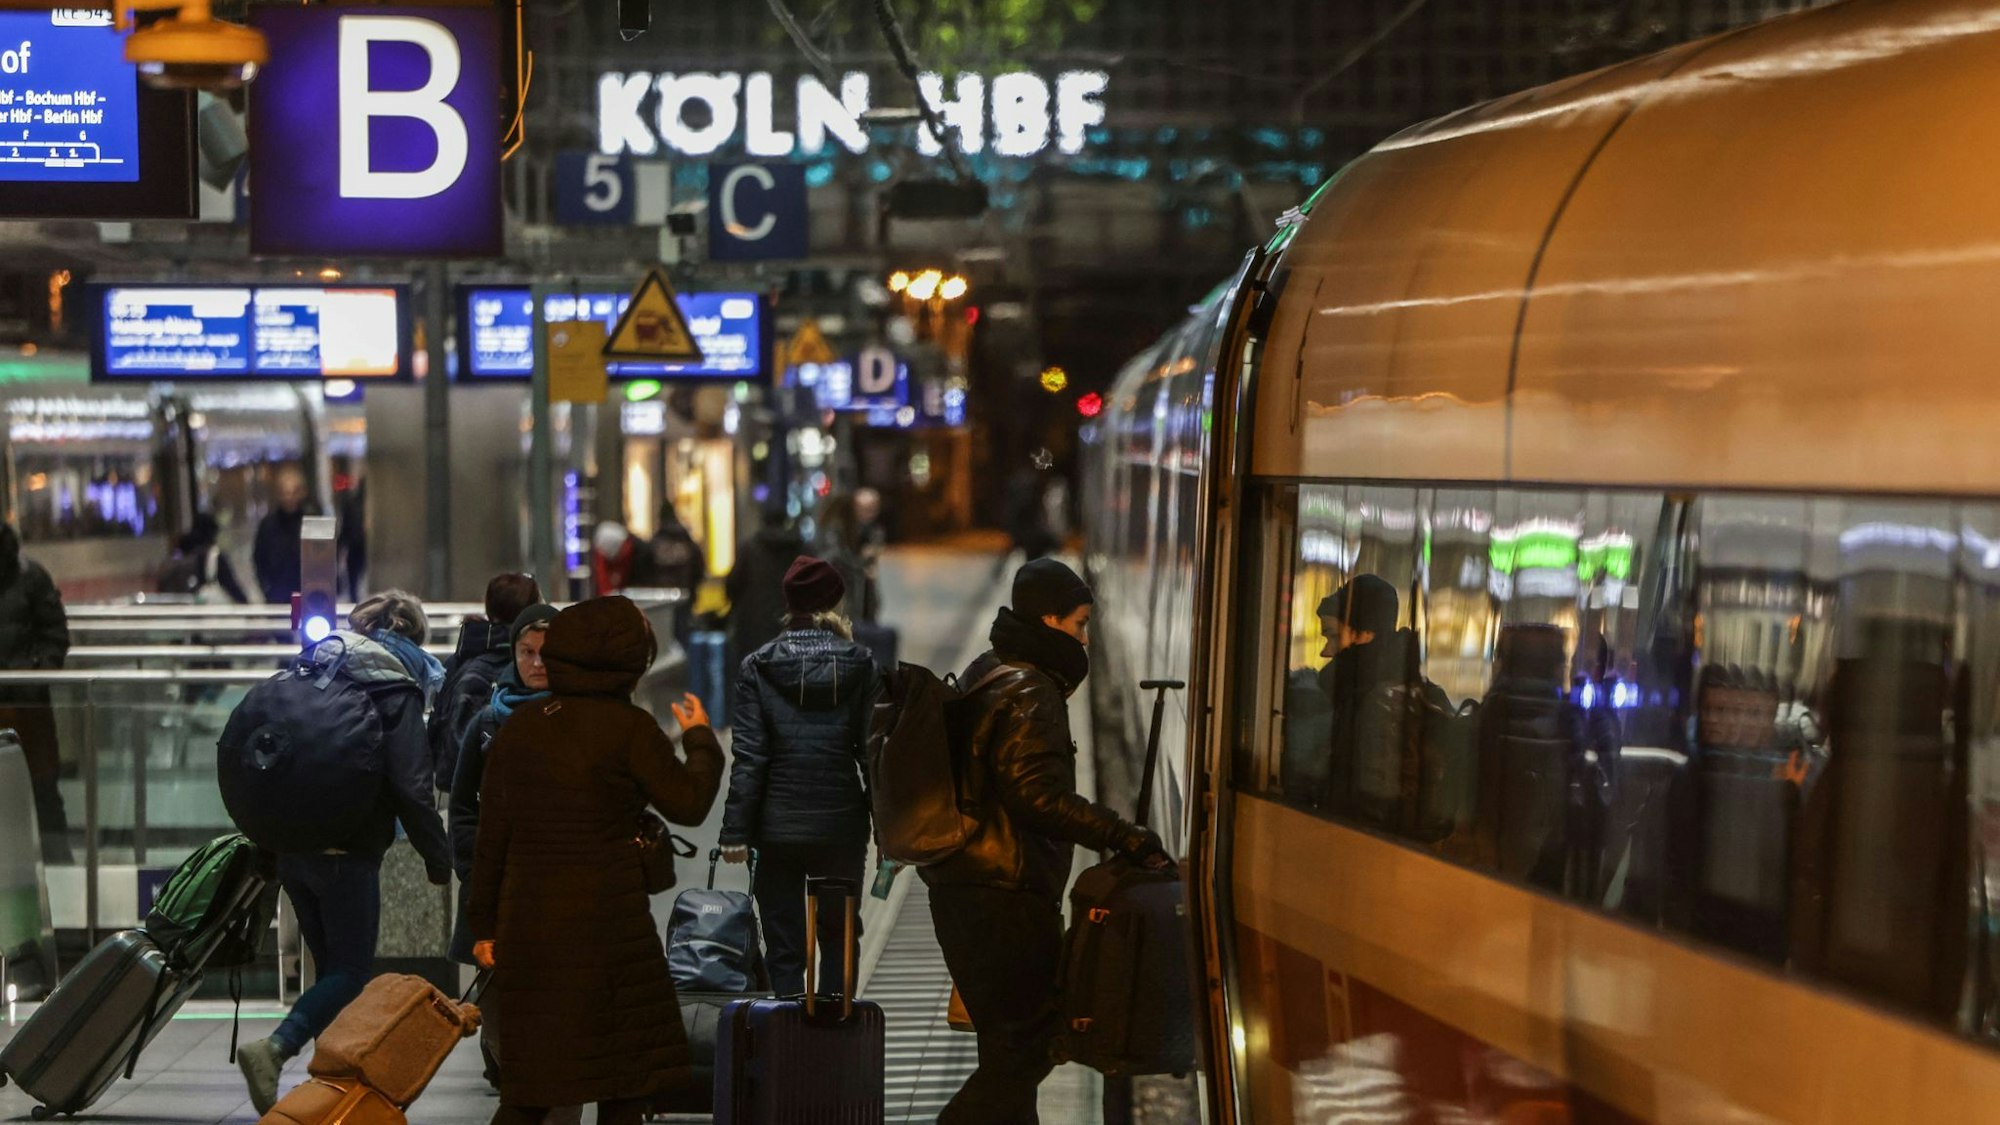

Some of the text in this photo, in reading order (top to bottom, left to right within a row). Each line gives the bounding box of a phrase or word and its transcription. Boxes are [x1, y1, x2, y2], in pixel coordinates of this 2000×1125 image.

[10, 108, 33, 124] Hbf
[44, 108, 79, 124] Berlin
[81, 109, 103, 124] Hbf
[25, 89, 73, 106] Bochum
[74, 90, 97, 106] Hbf
[338, 15, 469, 199] B
[917, 70, 1109, 156] HBF
[23, 129, 29, 141] F
[583, 155, 623, 212] 5
[720, 165, 777, 241] C
[858, 348, 896, 394] D
